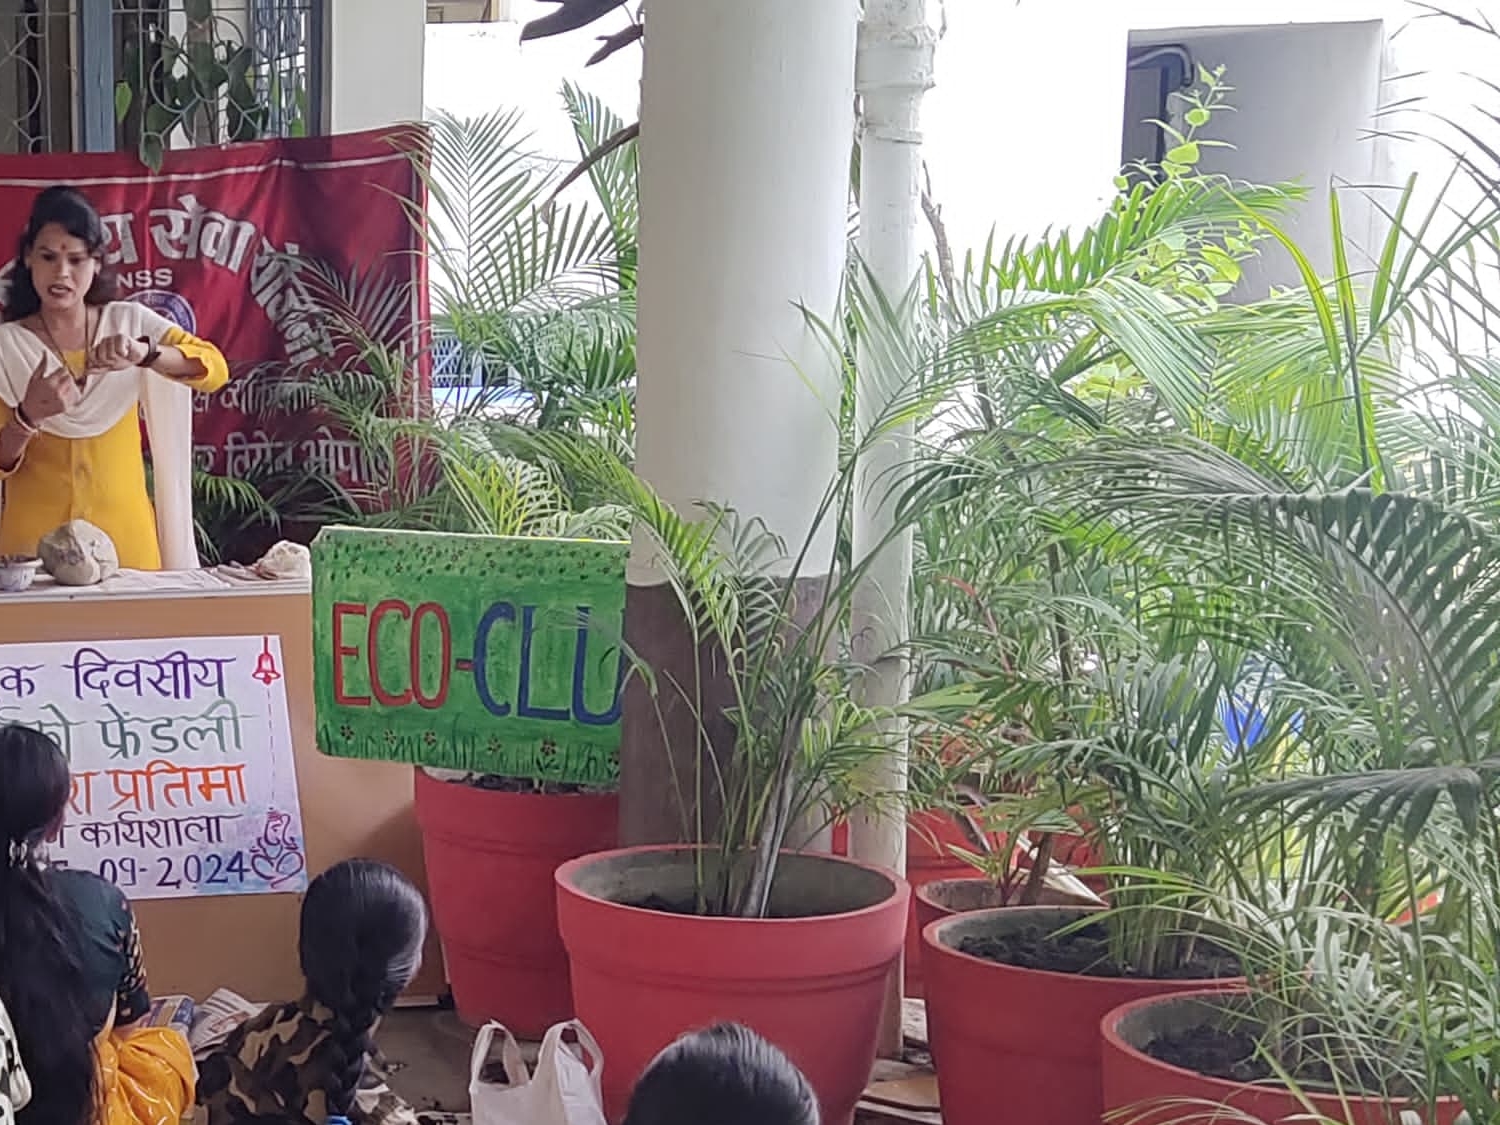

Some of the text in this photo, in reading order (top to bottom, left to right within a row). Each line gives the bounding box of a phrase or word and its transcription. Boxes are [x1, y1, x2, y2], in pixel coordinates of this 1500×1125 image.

[148, 193, 256, 274] सेवा
[115, 267, 174, 289] NSS
[62, 647, 237, 700] दिवसीय
[332, 598, 626, 726] ECO-CLU
[104, 759, 247, 812] प्रतिमा
[80, 810, 245, 850] कार्यशाला
